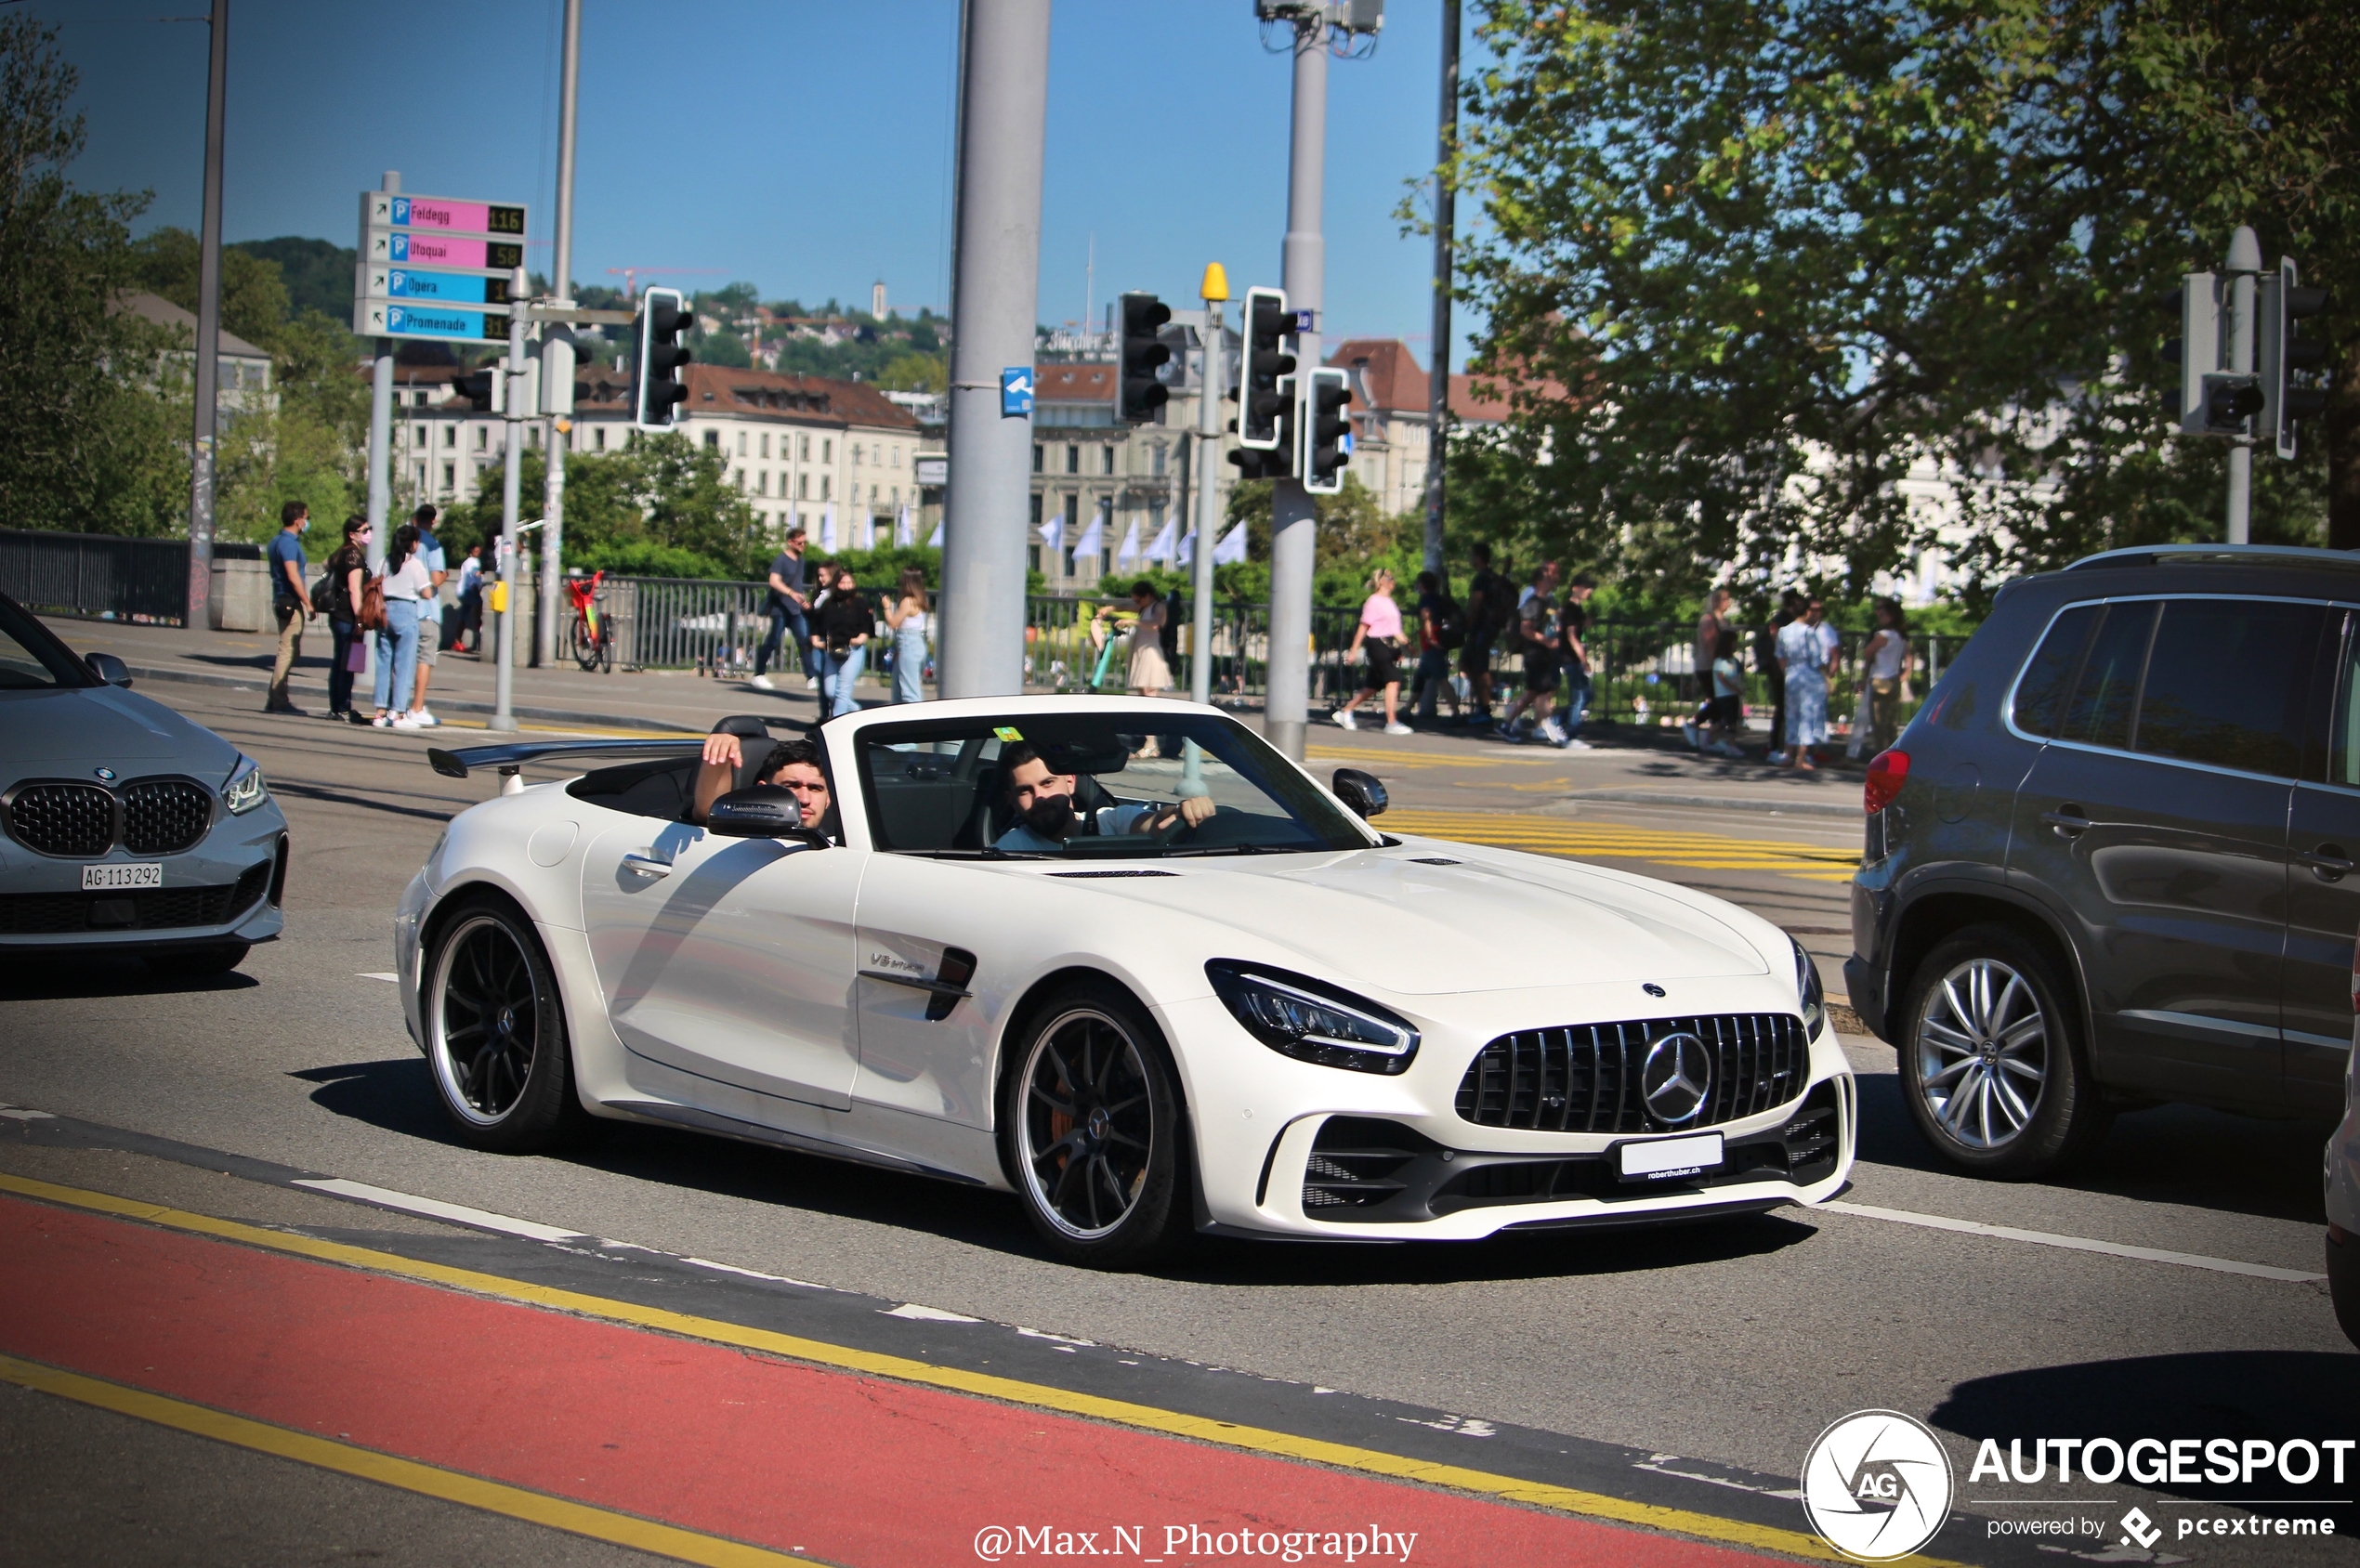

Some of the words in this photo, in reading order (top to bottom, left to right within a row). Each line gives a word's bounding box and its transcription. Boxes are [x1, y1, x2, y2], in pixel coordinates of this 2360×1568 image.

[411, 205, 450, 225] Feldegg
[489, 209, 520, 230] 116
[410, 242, 447, 260] Utoquai
[497, 247, 518, 266] 58
[409, 277, 438, 294] Opéra
[406, 314, 465, 332] Promenade
[1647, 1166, 1701, 1180] roberthuber.ch
